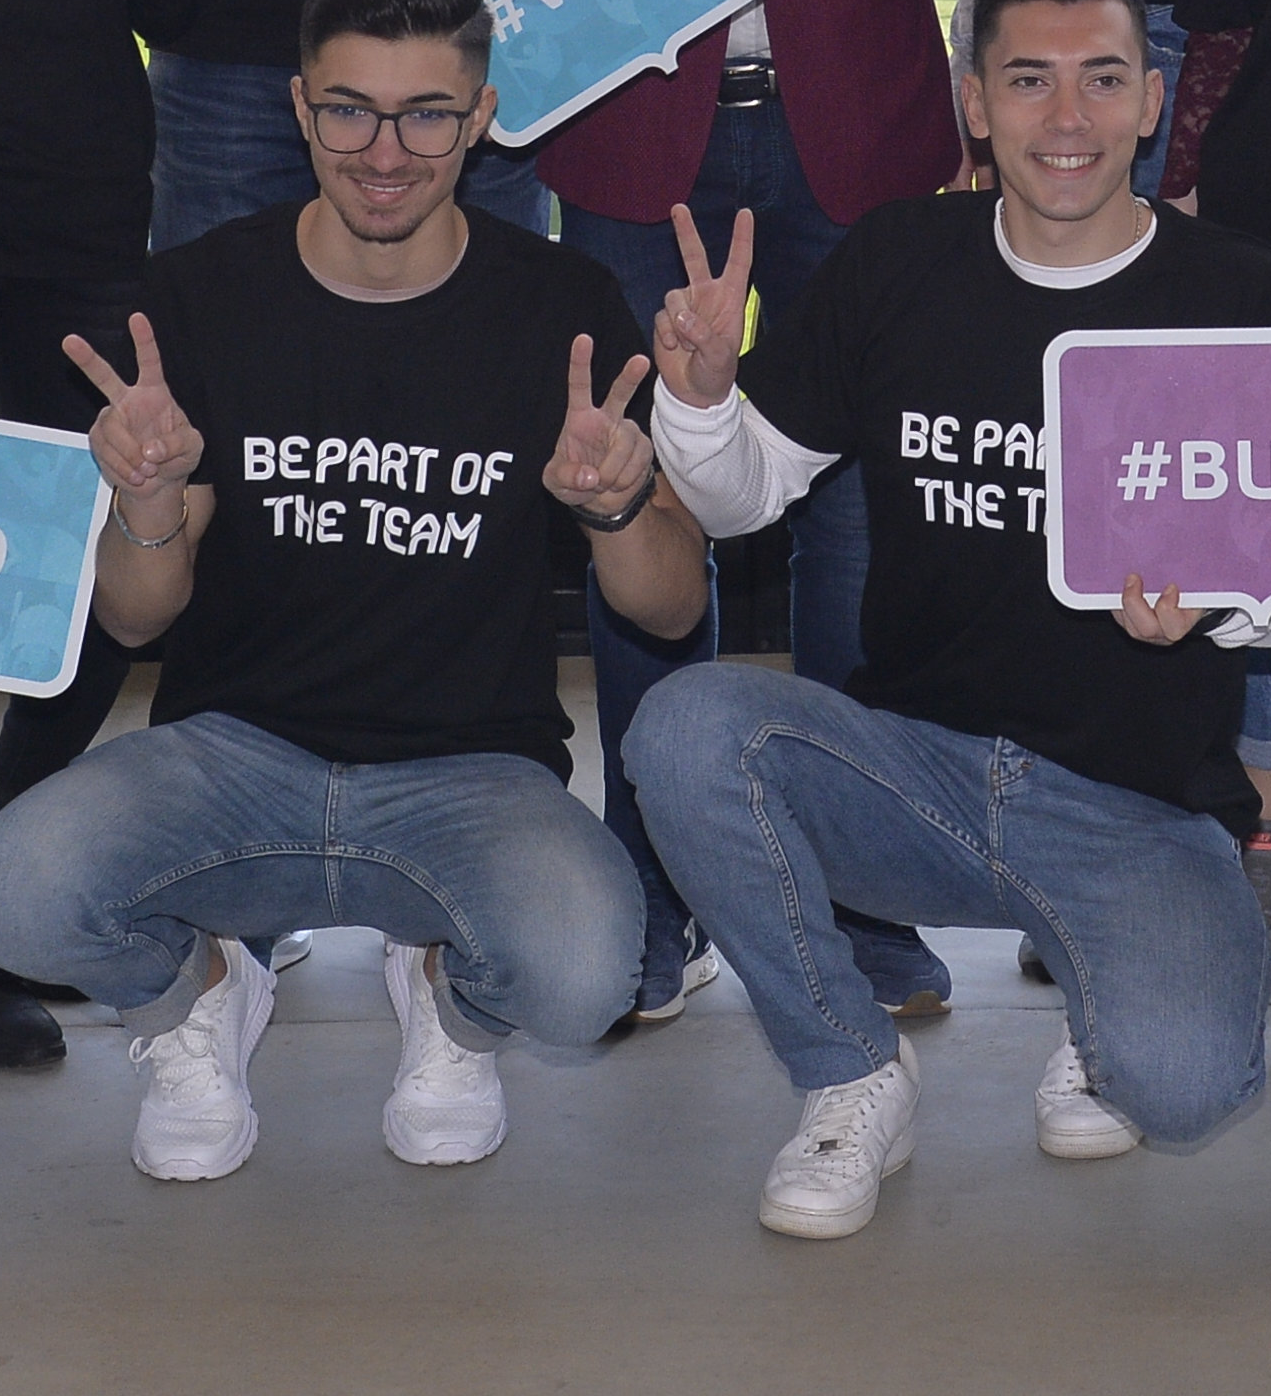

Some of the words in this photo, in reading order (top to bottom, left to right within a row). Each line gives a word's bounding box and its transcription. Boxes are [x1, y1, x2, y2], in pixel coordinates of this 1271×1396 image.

[900, 411, 960, 463] BE
[243, 436, 311, 481] BE
[315, 437, 439, 494] PART
[450, 451, 514, 496] OF
[262, 494, 347, 545] THE
[360, 498, 482, 559] TEAM
[914, 477, 1006, 530] THE
